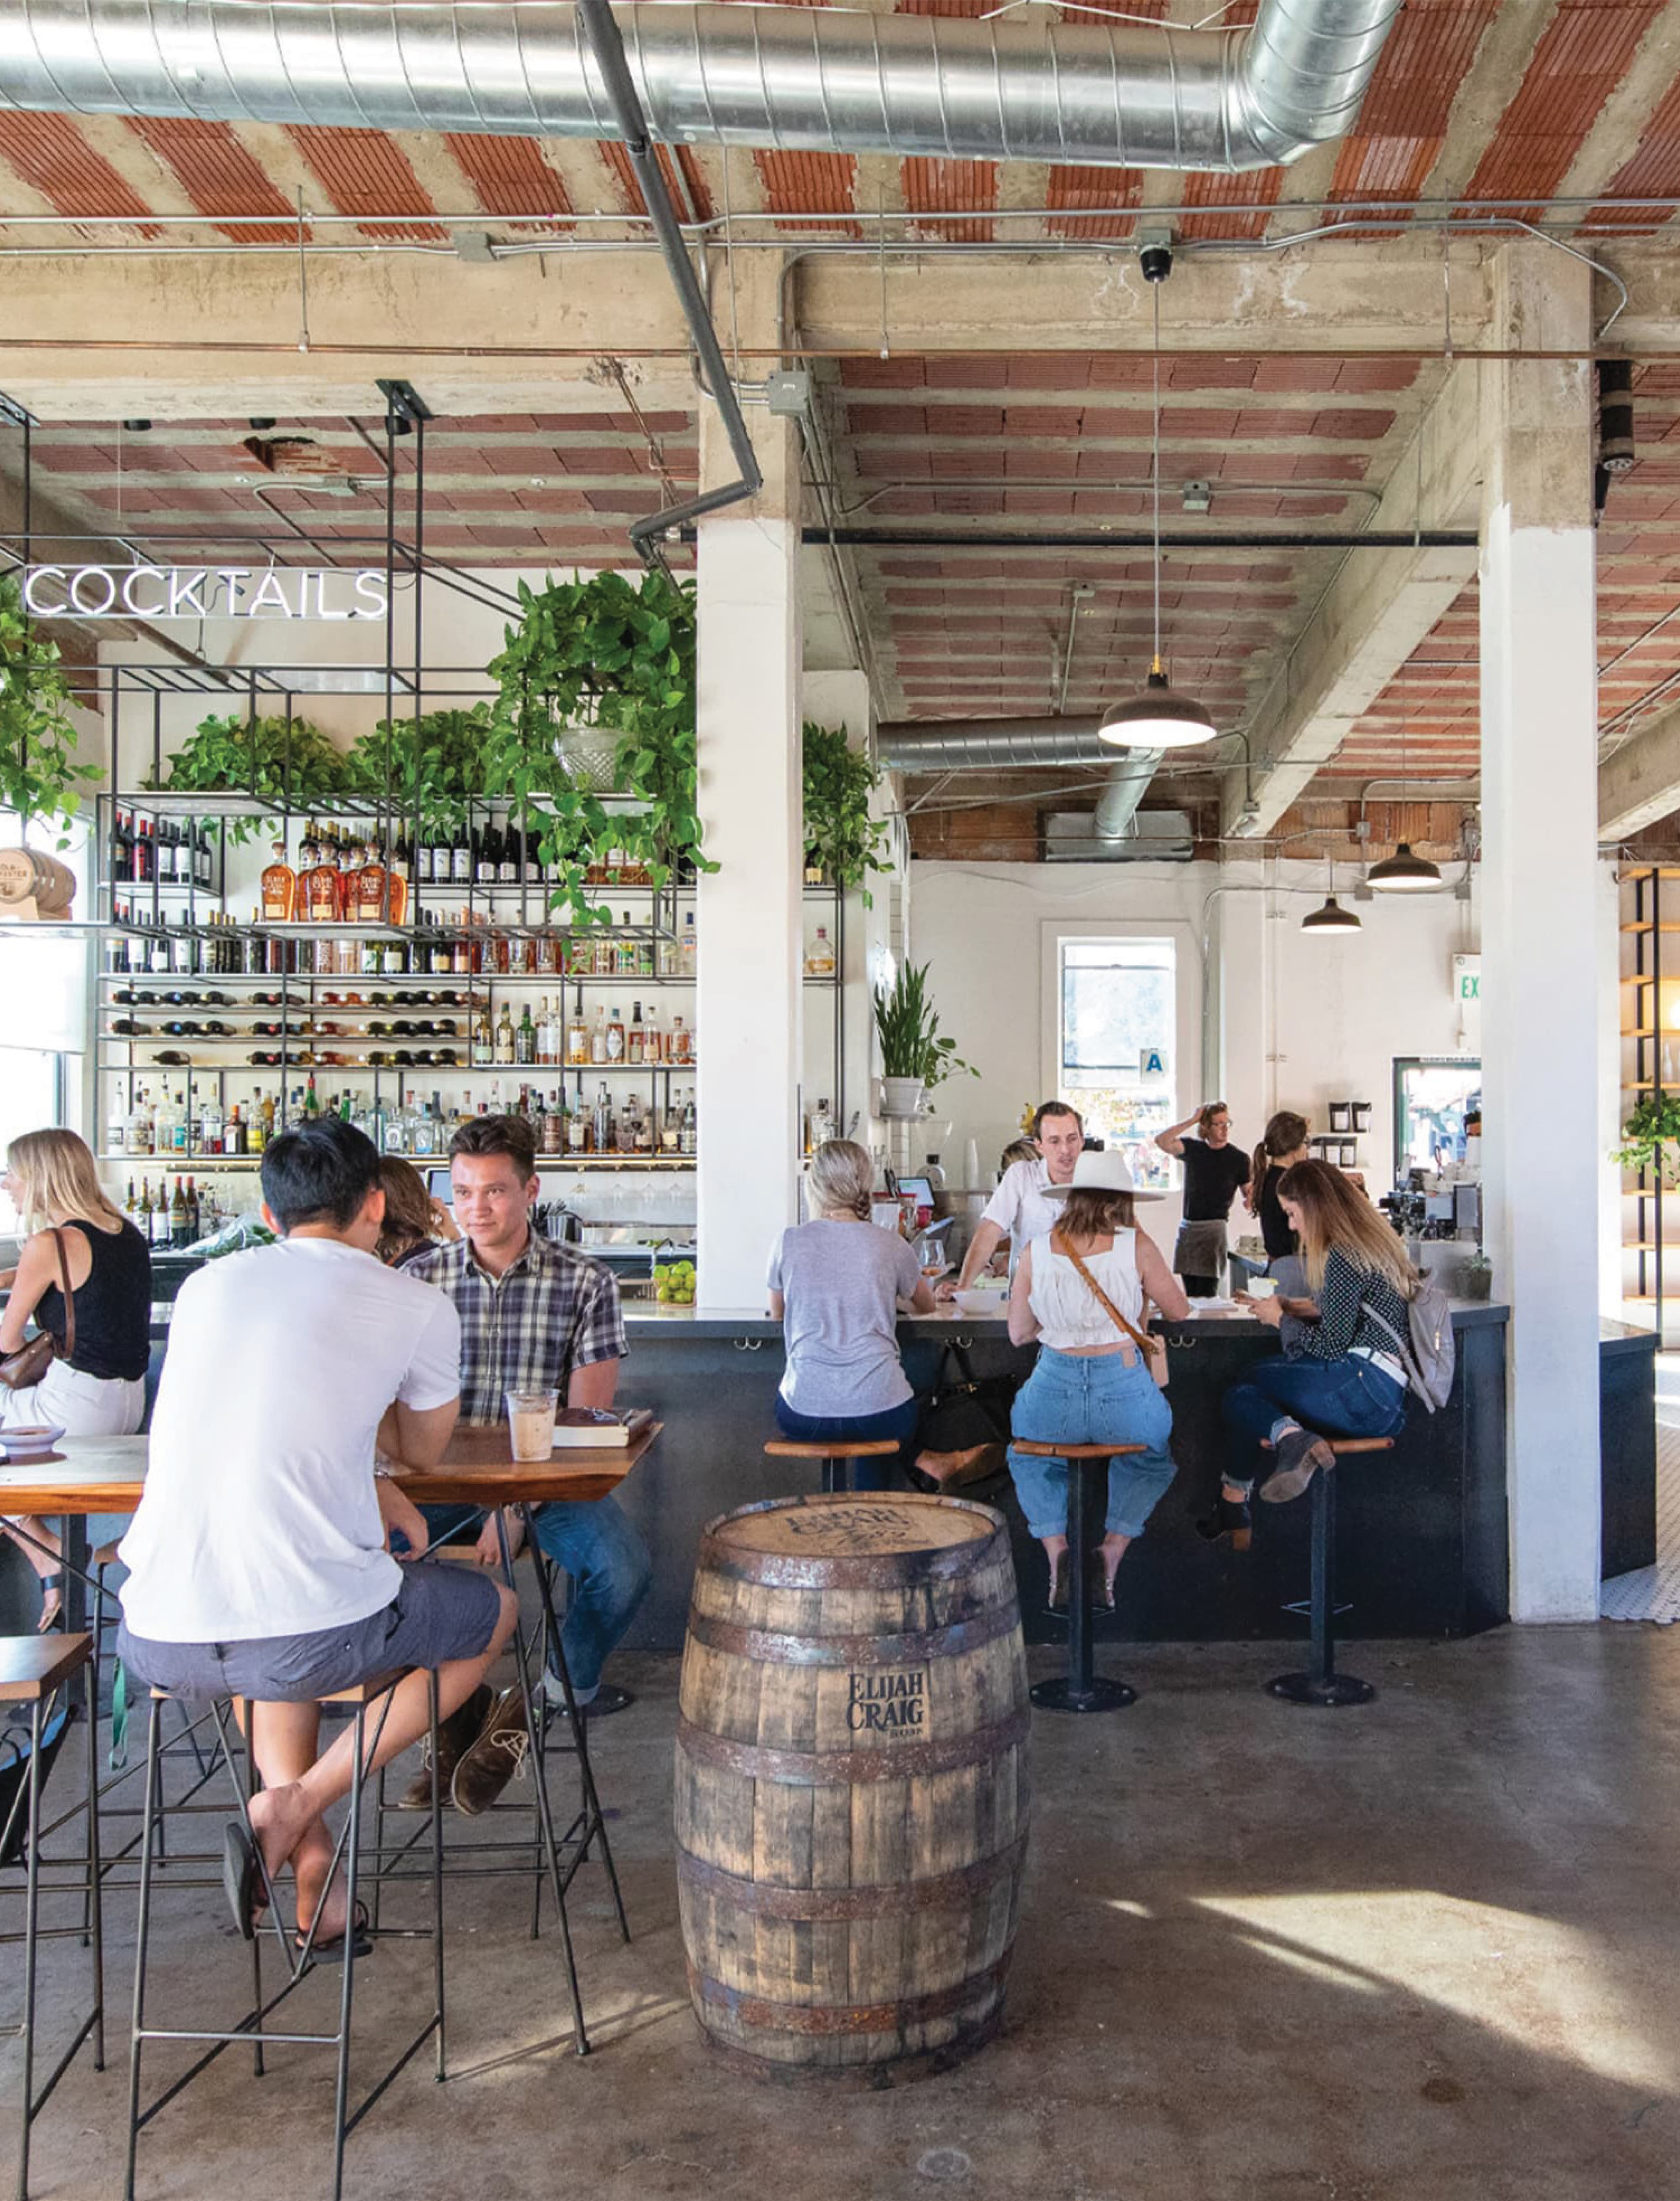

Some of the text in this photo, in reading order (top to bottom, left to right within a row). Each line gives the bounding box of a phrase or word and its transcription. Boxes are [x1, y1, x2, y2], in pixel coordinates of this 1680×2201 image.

[25, 567, 387, 617] COCKTAILS
[1462, 976, 1479, 998] EX
[1146, 1053, 1163, 1072] A
[847, 1672, 923, 1701] ELIJAH
[846, 1699, 924, 1731] CRAIG
